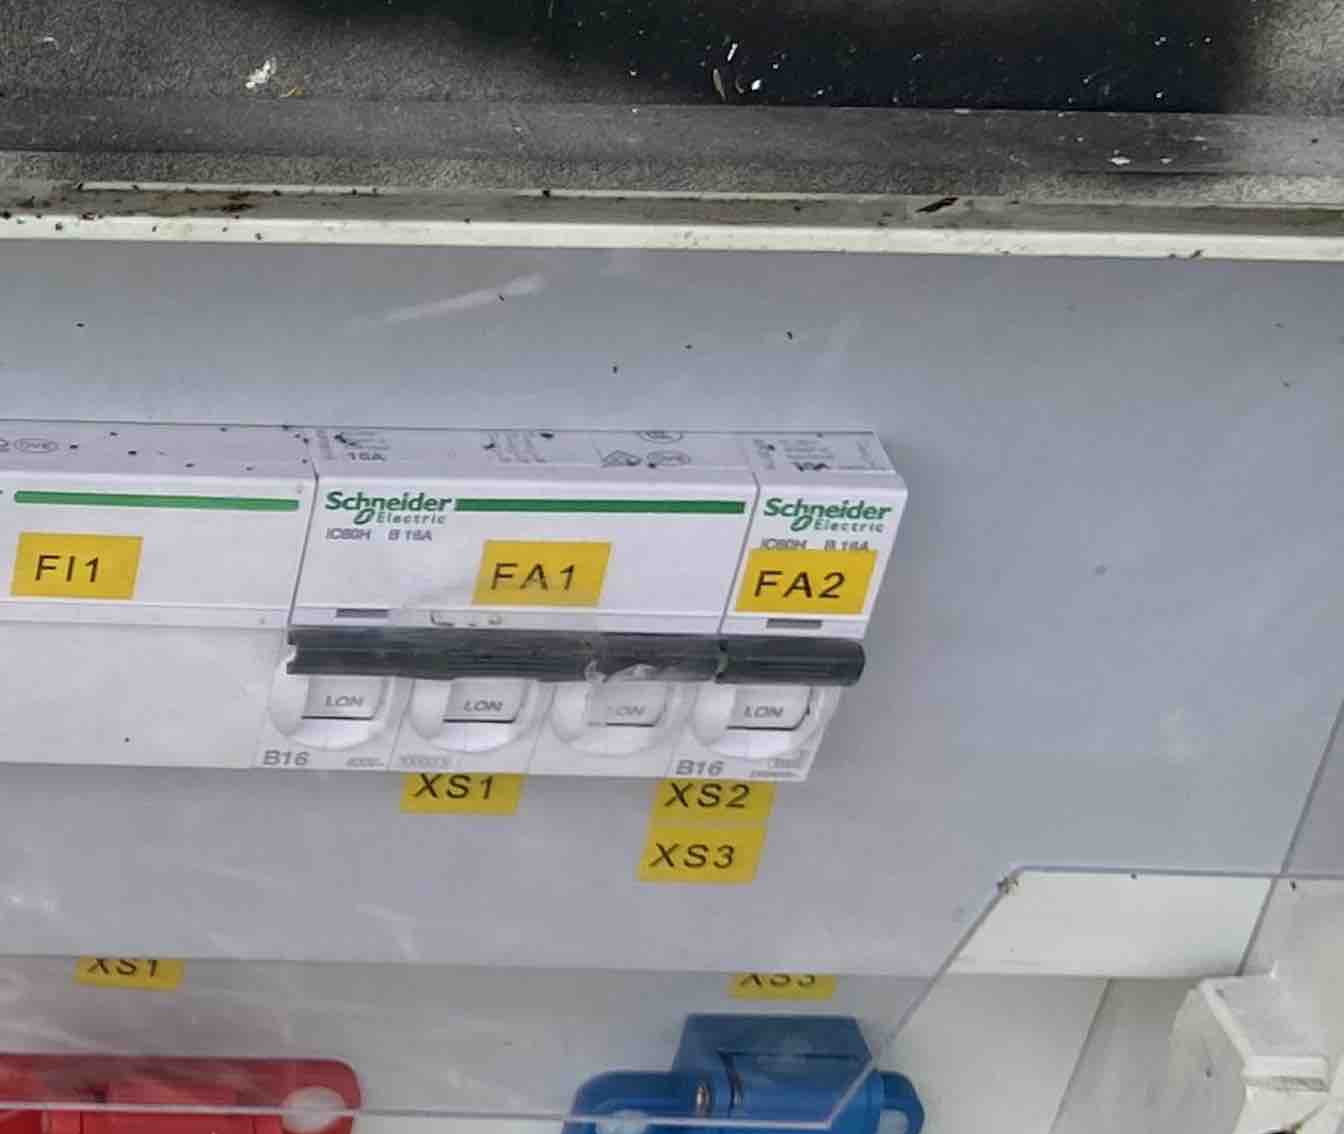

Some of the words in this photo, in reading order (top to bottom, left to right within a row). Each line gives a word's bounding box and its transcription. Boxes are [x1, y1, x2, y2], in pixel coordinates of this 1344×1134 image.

[324, 491, 452, 512] Schneider
[763, 497, 892, 520] Schneider
[376, 511, 446, 525] Electric
[814, 519, 885, 533] Electric
[35, 555, 101, 584] FI1
[490, 562, 579, 591] FA1
[753, 570, 847, 600] FA2
[263, 750, 310, 766] B16
[676, 759, 725, 776] B16
[412, 773, 494, 800] XS1
[664, 781, 751, 808] XS2
[648, 842, 735, 869] XS3
